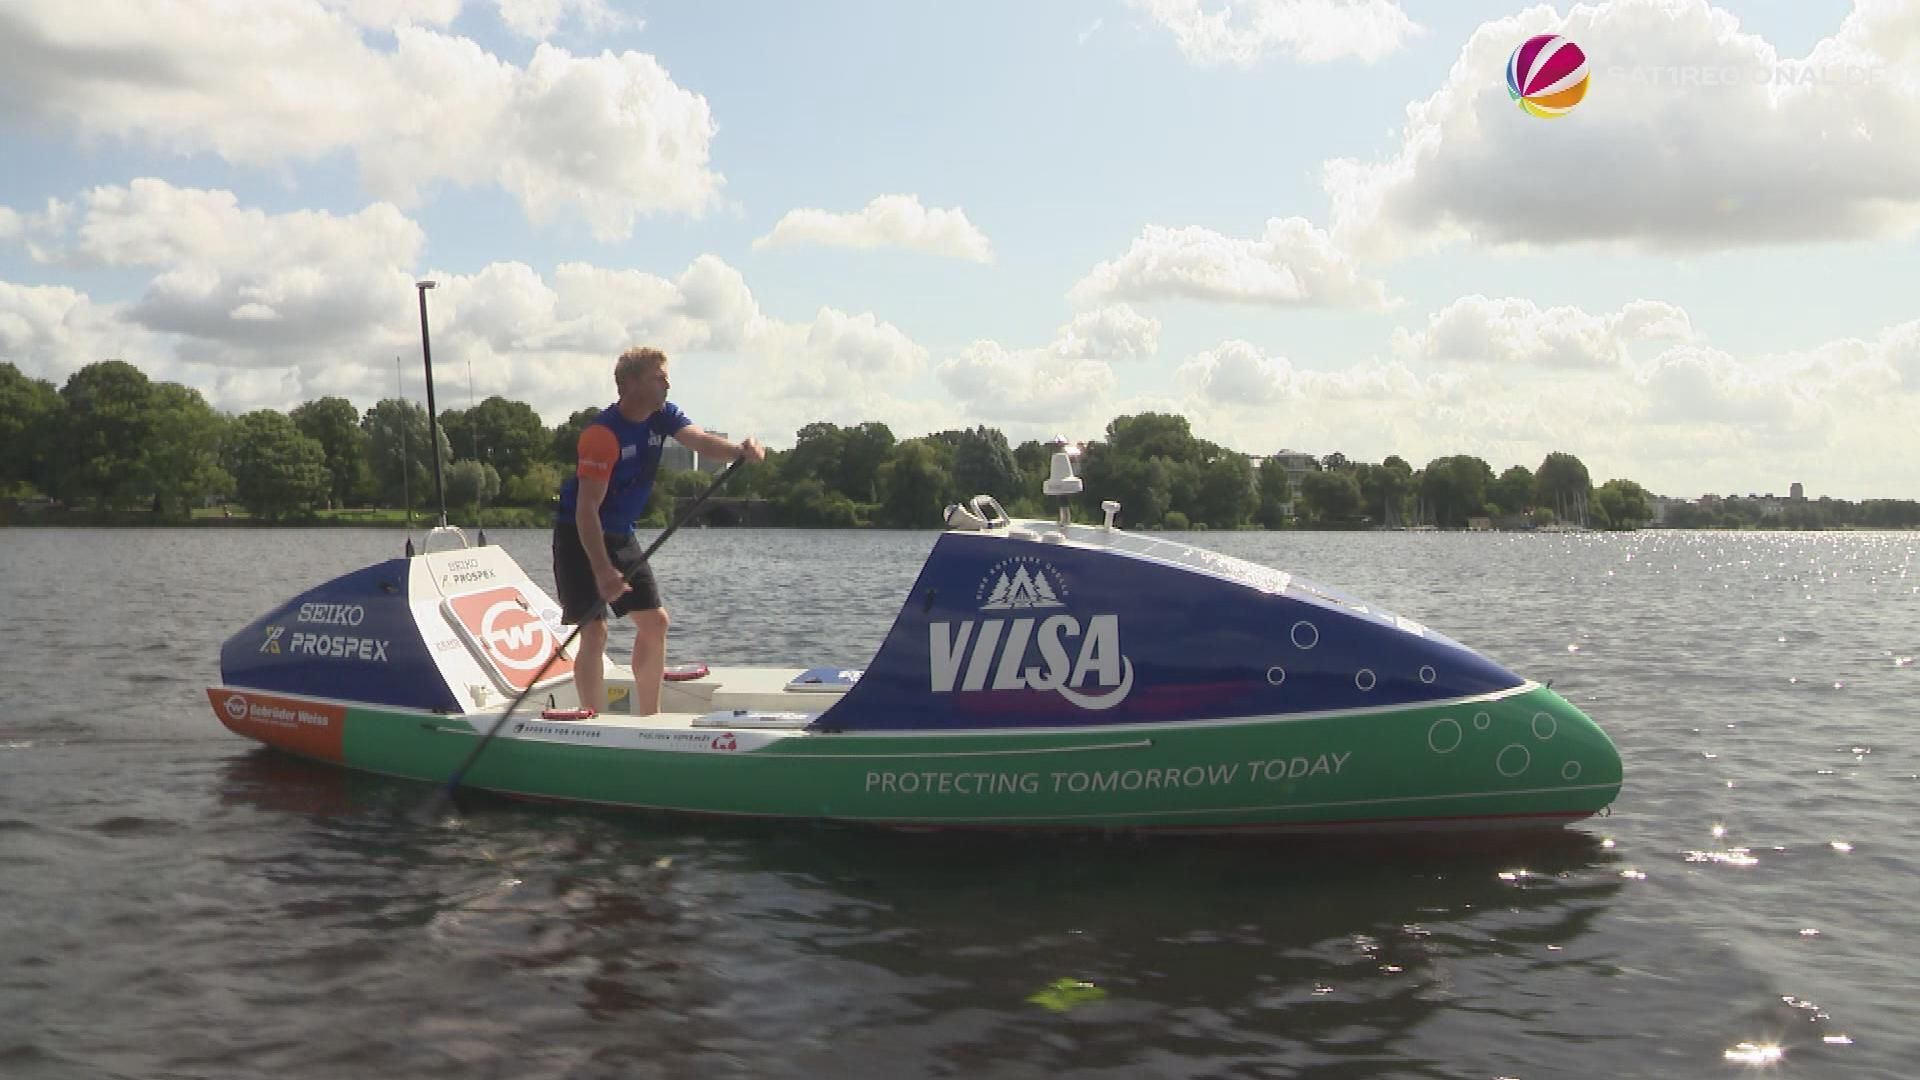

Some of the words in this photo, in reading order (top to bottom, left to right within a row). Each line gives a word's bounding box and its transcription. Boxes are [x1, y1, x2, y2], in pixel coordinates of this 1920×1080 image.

[453, 569, 496, 584] PROSPEX
[297, 602, 365, 626] SEIKO
[289, 632, 389, 662] PROSPEX
[929, 614, 1134, 710] VILSA
[297, 710, 329, 726] Weiss
[554, 728, 569, 736] FOR
[864, 771, 1039, 794] PROTECTING
[1051, 763, 1239, 794] TOMORROW
[1247, 751, 1352, 783] TODAY
